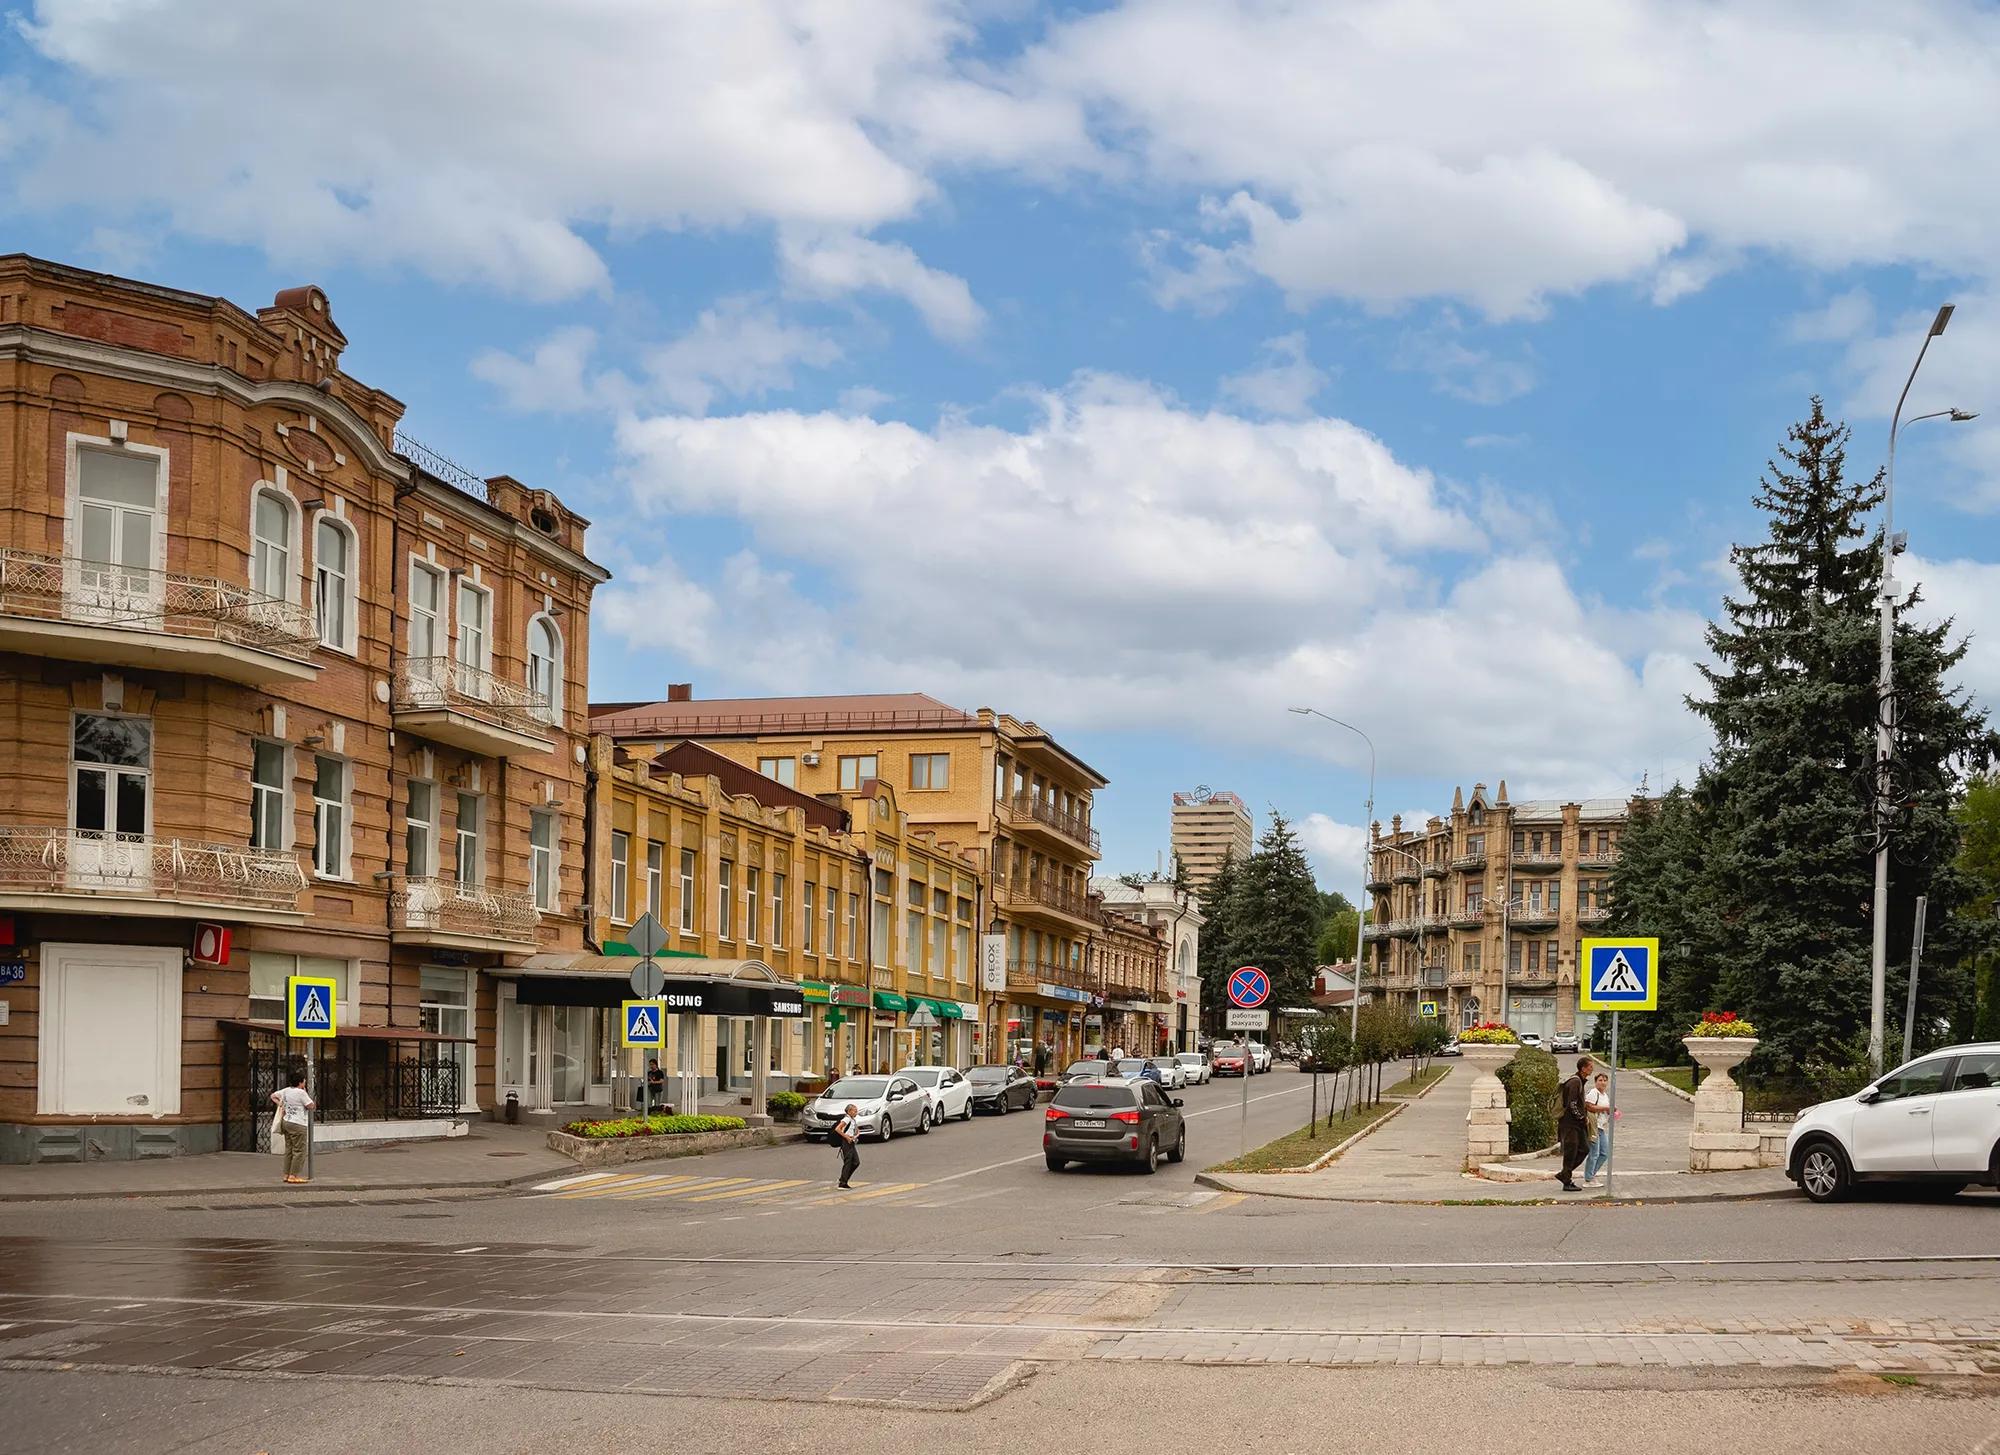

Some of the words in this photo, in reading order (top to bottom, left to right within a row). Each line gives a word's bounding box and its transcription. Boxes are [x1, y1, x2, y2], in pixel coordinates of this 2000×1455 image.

[12, 965, 24, 979] 36
[773, 1001, 802, 1014] SAMSUNG
[1232, 1012, 1262, 1020] работает
[1230, 1020, 1263, 1028] эвакуатор
